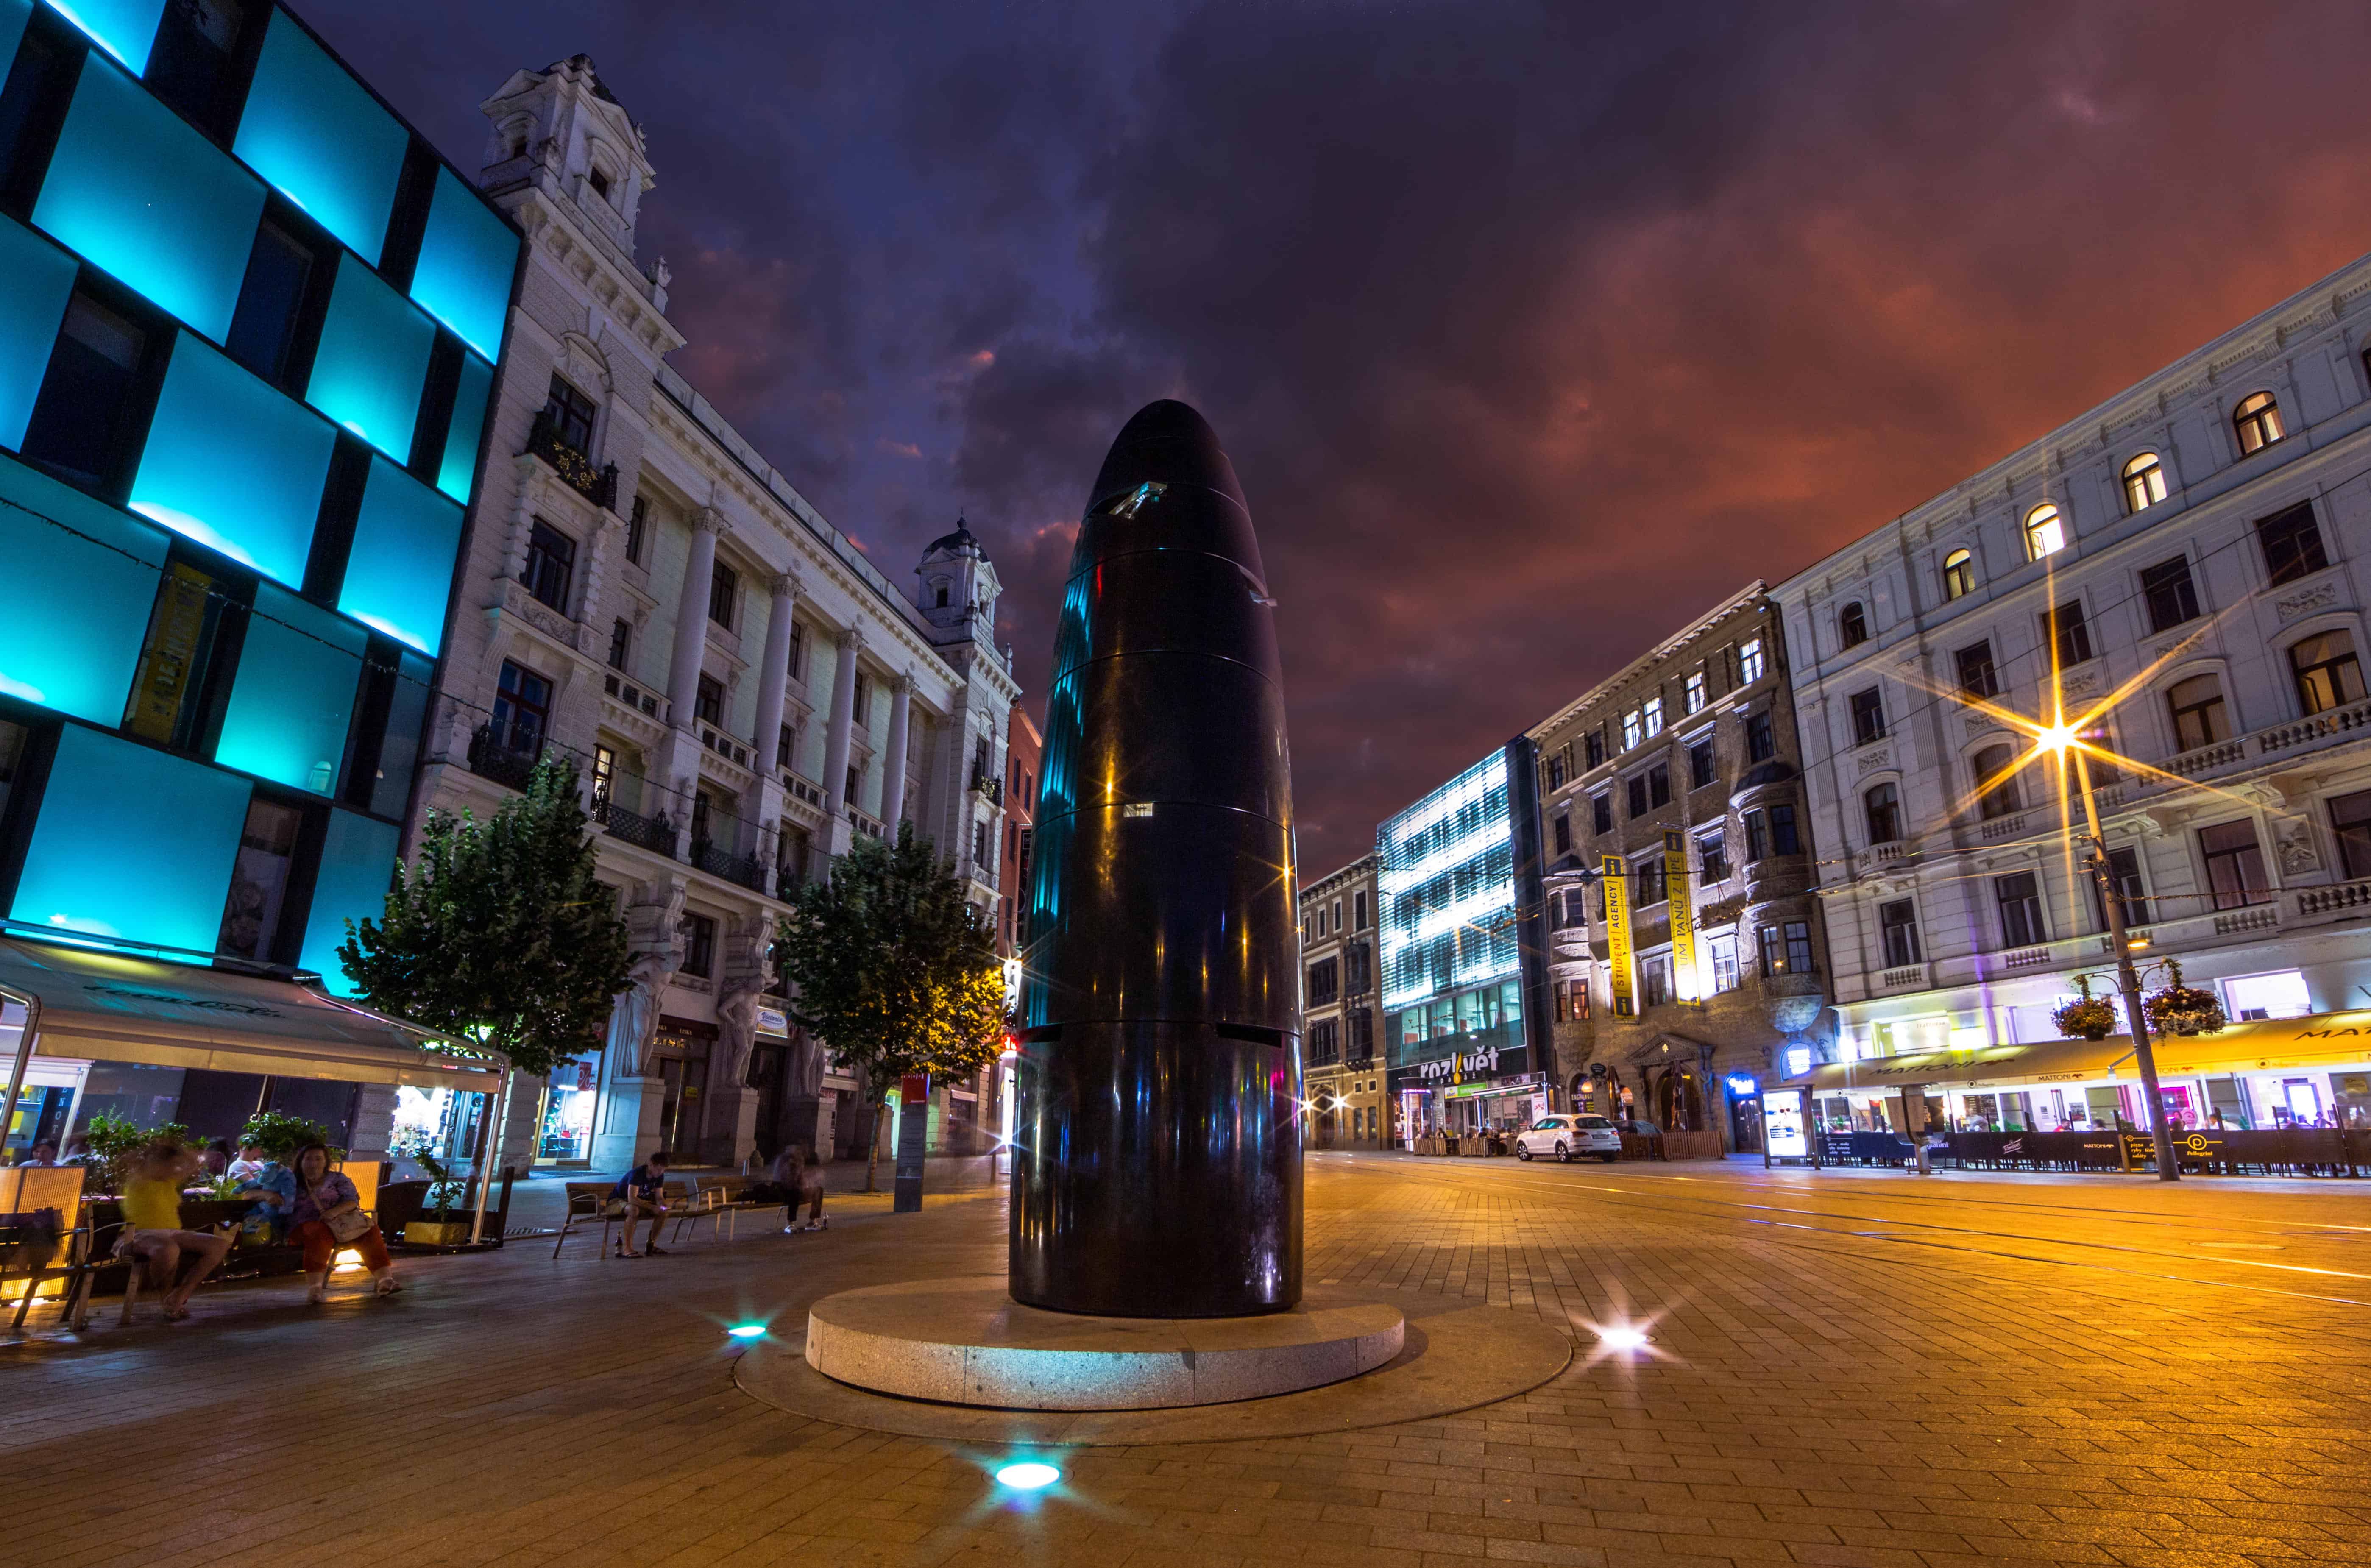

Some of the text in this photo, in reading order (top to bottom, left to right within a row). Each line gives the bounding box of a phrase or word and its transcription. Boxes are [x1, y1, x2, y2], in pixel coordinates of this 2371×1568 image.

[1609, 886, 1625, 986] STUDENT AGENCY
[761, 1012, 783, 1022] Victoria
[1869, 1061, 1975, 1075] MATTONI
[2038, 1073, 2071, 1082] MATTONI
